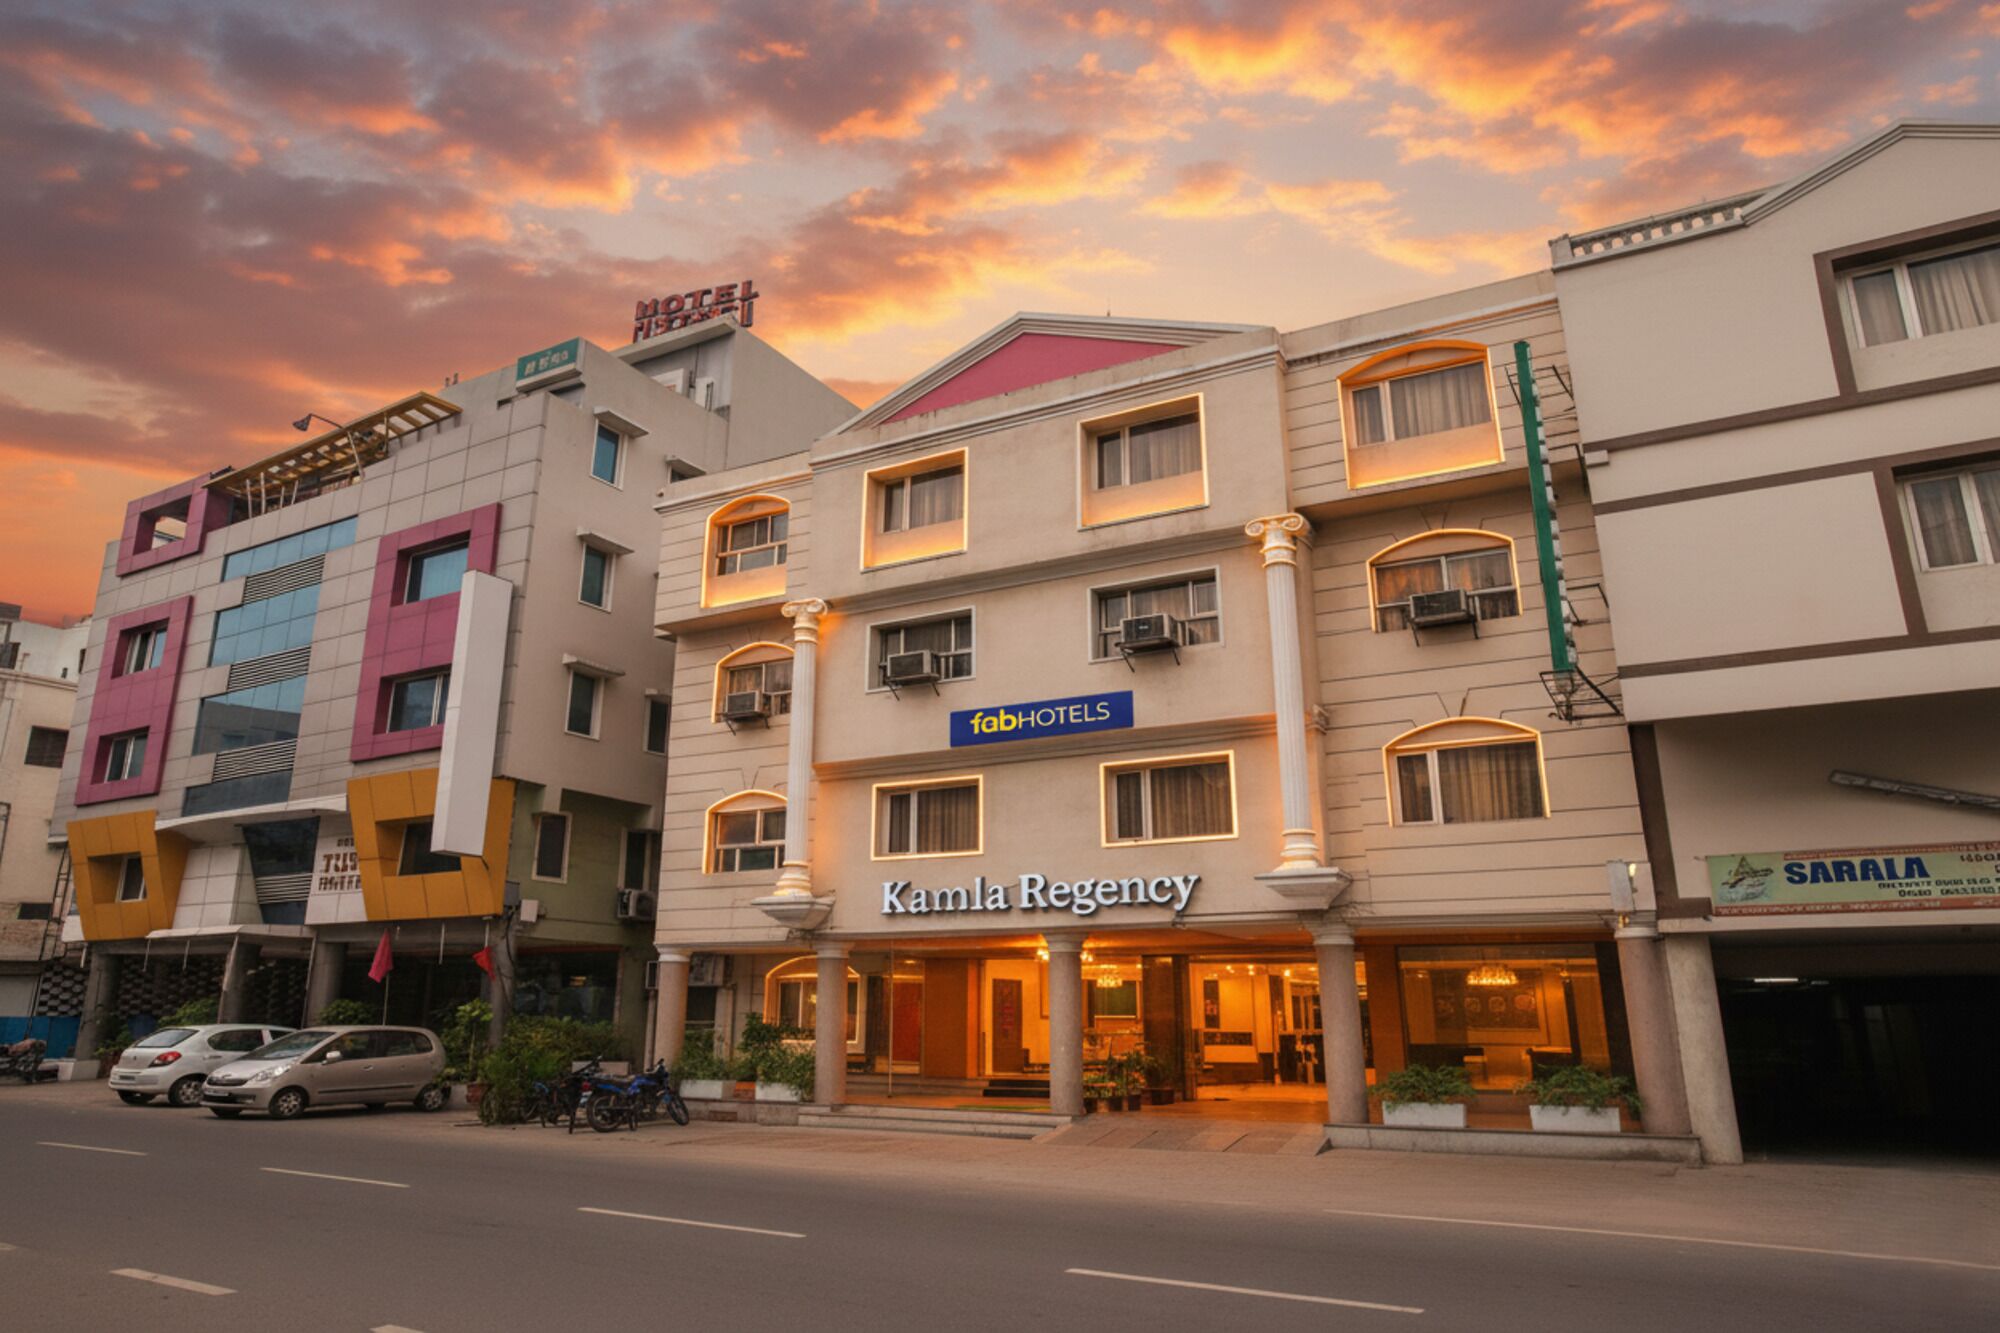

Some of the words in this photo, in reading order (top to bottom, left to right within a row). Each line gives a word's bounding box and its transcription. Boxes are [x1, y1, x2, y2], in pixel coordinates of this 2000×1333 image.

[1783, 856, 1931, 885] SARALA
[880, 876, 1012, 915] Kamla
[1018, 873, 1199, 915] Regency
